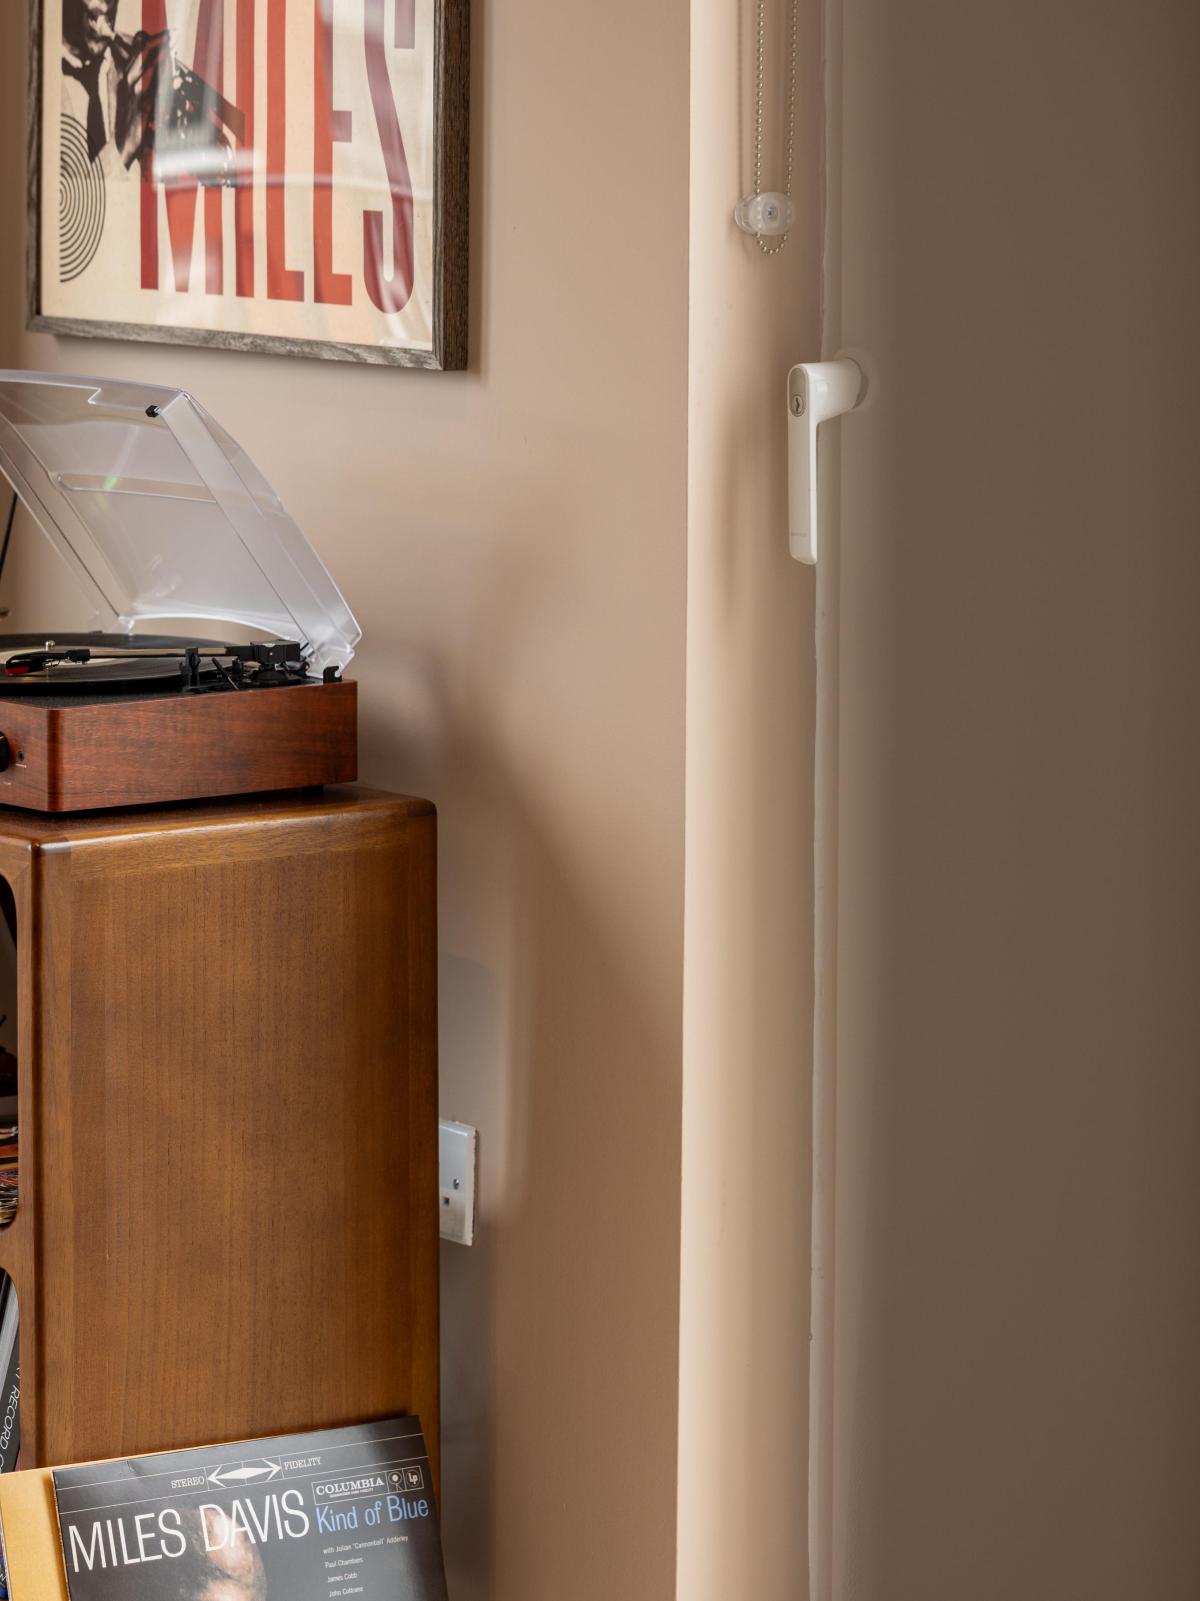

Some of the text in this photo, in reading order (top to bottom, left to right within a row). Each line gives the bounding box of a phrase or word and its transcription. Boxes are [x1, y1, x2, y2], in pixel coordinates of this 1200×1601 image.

[140, 0, 415, 314] MILES
[0, 1384, 20, 1450] RECORD
[171, 1456, 322, 1489] STEREO FIDELITY
[315, 1476, 384, 1496] COLUMBIA
[68, 1508, 187, 1573] MILES
[198, 1489, 310, 1552] DAVIS
[315, 1505, 358, 1534] Kind
[364, 1501, 382, 1526] of
[386, 1495, 429, 1523] Blue
[322, 1545, 335, 1554] with
[325, 1560, 337, 1569] Paul
[329, 1588, 341, 1598] John
